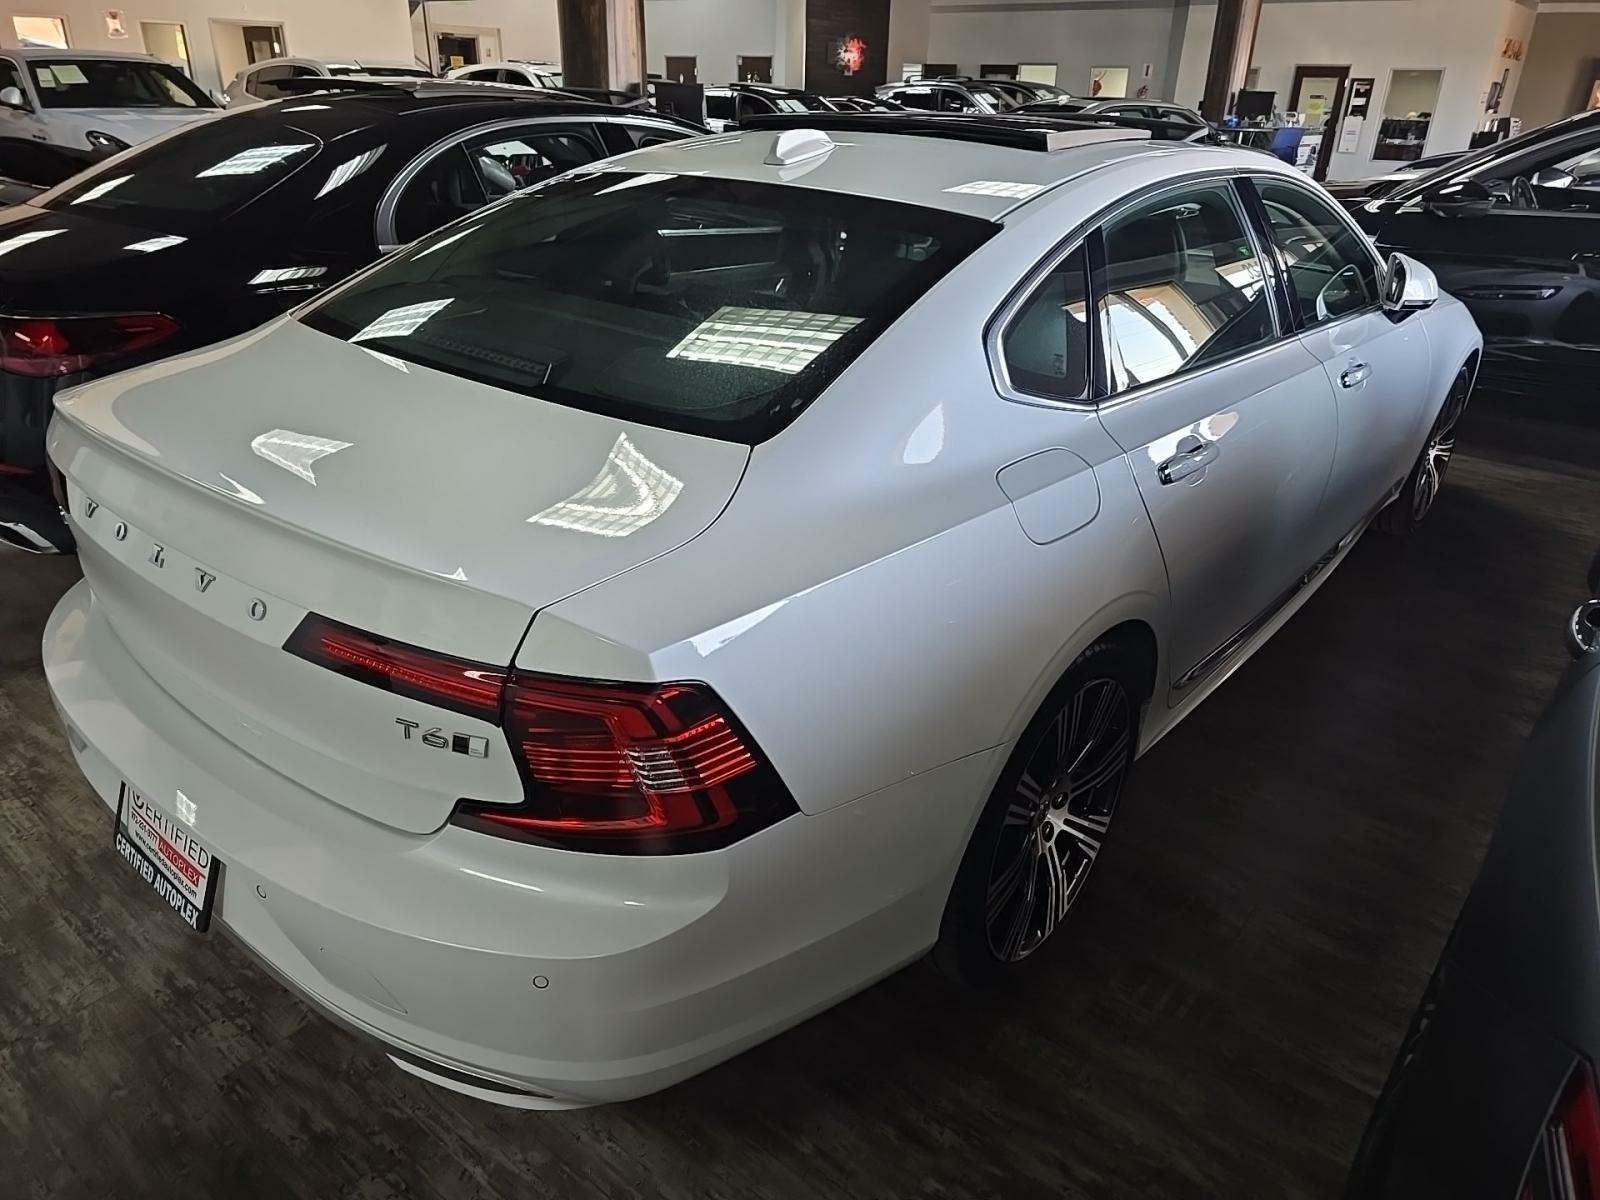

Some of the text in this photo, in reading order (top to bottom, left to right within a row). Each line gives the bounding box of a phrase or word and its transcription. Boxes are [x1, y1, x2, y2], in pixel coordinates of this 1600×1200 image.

[85, 497, 267, 621] VOLVO
[395, 717, 449, 748] T6
[116, 834, 200, 929] CERTIFIED AUTOPLEX
[158, 841, 199, 886] AUTOPLEX
